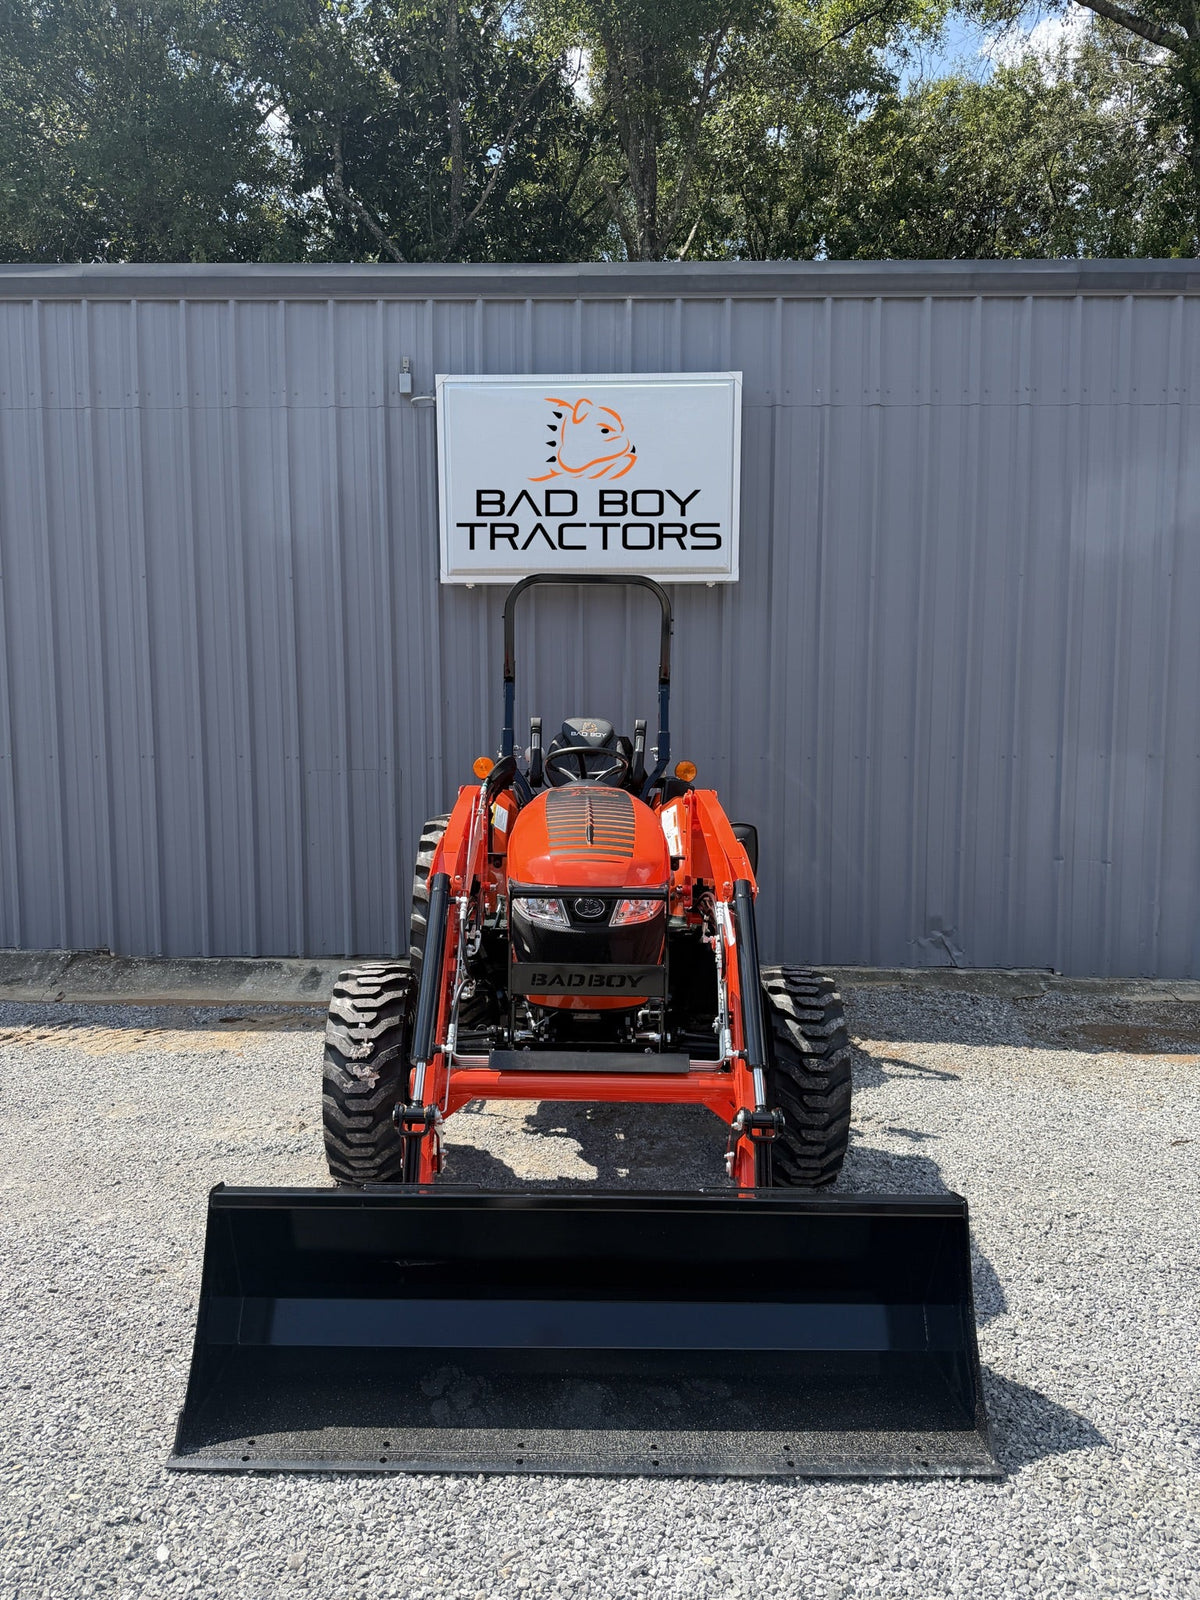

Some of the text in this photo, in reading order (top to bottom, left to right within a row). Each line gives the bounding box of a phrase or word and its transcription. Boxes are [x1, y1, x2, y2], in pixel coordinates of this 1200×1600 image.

[476, 489, 701, 517] BAD BOY
[456, 523, 722, 551] TRACTORS
